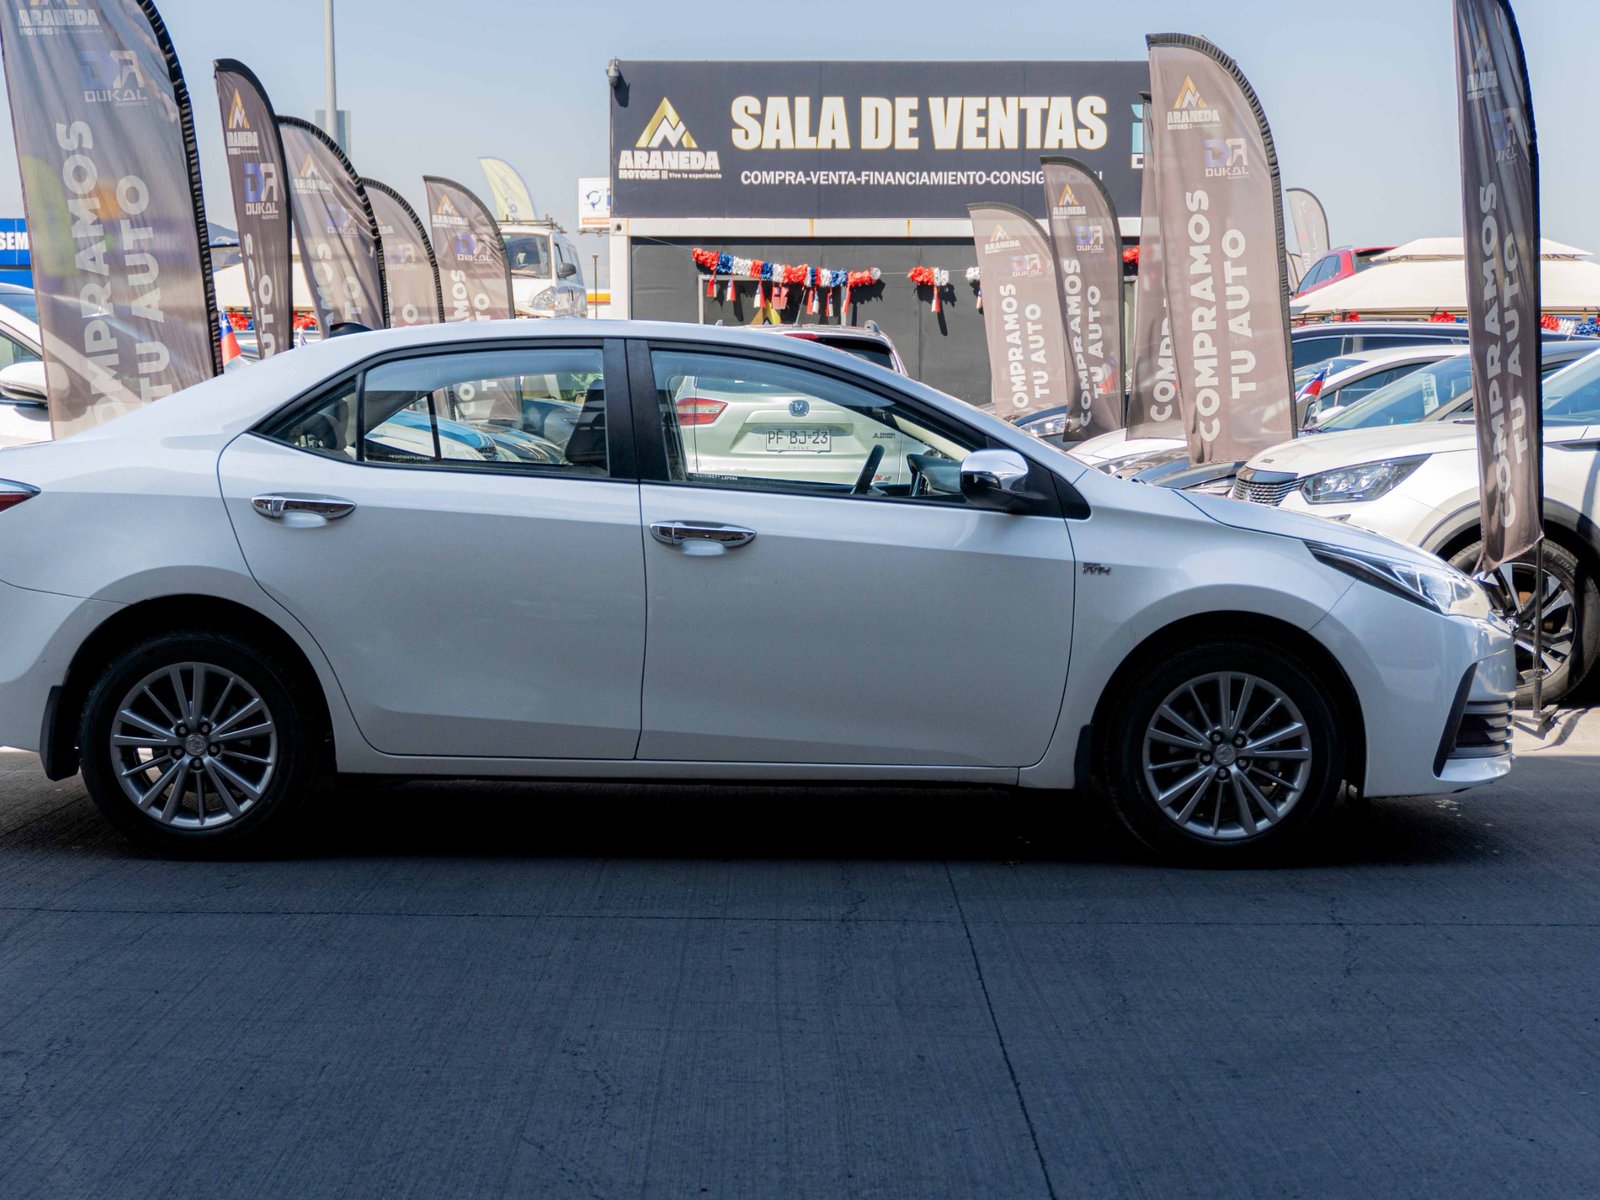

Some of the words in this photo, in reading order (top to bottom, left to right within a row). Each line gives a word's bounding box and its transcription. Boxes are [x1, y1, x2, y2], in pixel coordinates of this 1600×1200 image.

[18, 8, 100, 26] ARANEDA
[84, 89, 148, 102] DUKAL
[1167, 109, 1221, 124] ARANEDA
[731, 95, 851, 150] SALA
[860, 96, 919, 150] DE
[928, 95, 1108, 150] VENTAS
[619, 150, 720, 170] ARANEDA
[619, 170, 660, 180] MOTORS
[1205, 167, 1250, 178] DUKAL
[245, 202, 279, 215] DUKAL
[1053, 206, 1087, 216] ARANEDA
[115, 174, 165, 323] AUTO
[1221, 228, 1253, 338] AUTO
[1086, 285, 1105, 359] AUTO
[1185, 189, 1221, 442] COMPRAMOS
[1503, 232, 1523, 377] AUTO
[1024, 303, 1047, 365] AUTO
[1064, 258, 1092, 427] COMPRAMOS
[1230, 349, 1257, 399] TU
[1479, 182, 1517, 529] COMPRAMOS
[1032, 370, 1050, 399] TU
[1090, 365, 1106, 399] TU
[812, 430, 829, 445] 23
[1509, 394, 1529, 464] TU
